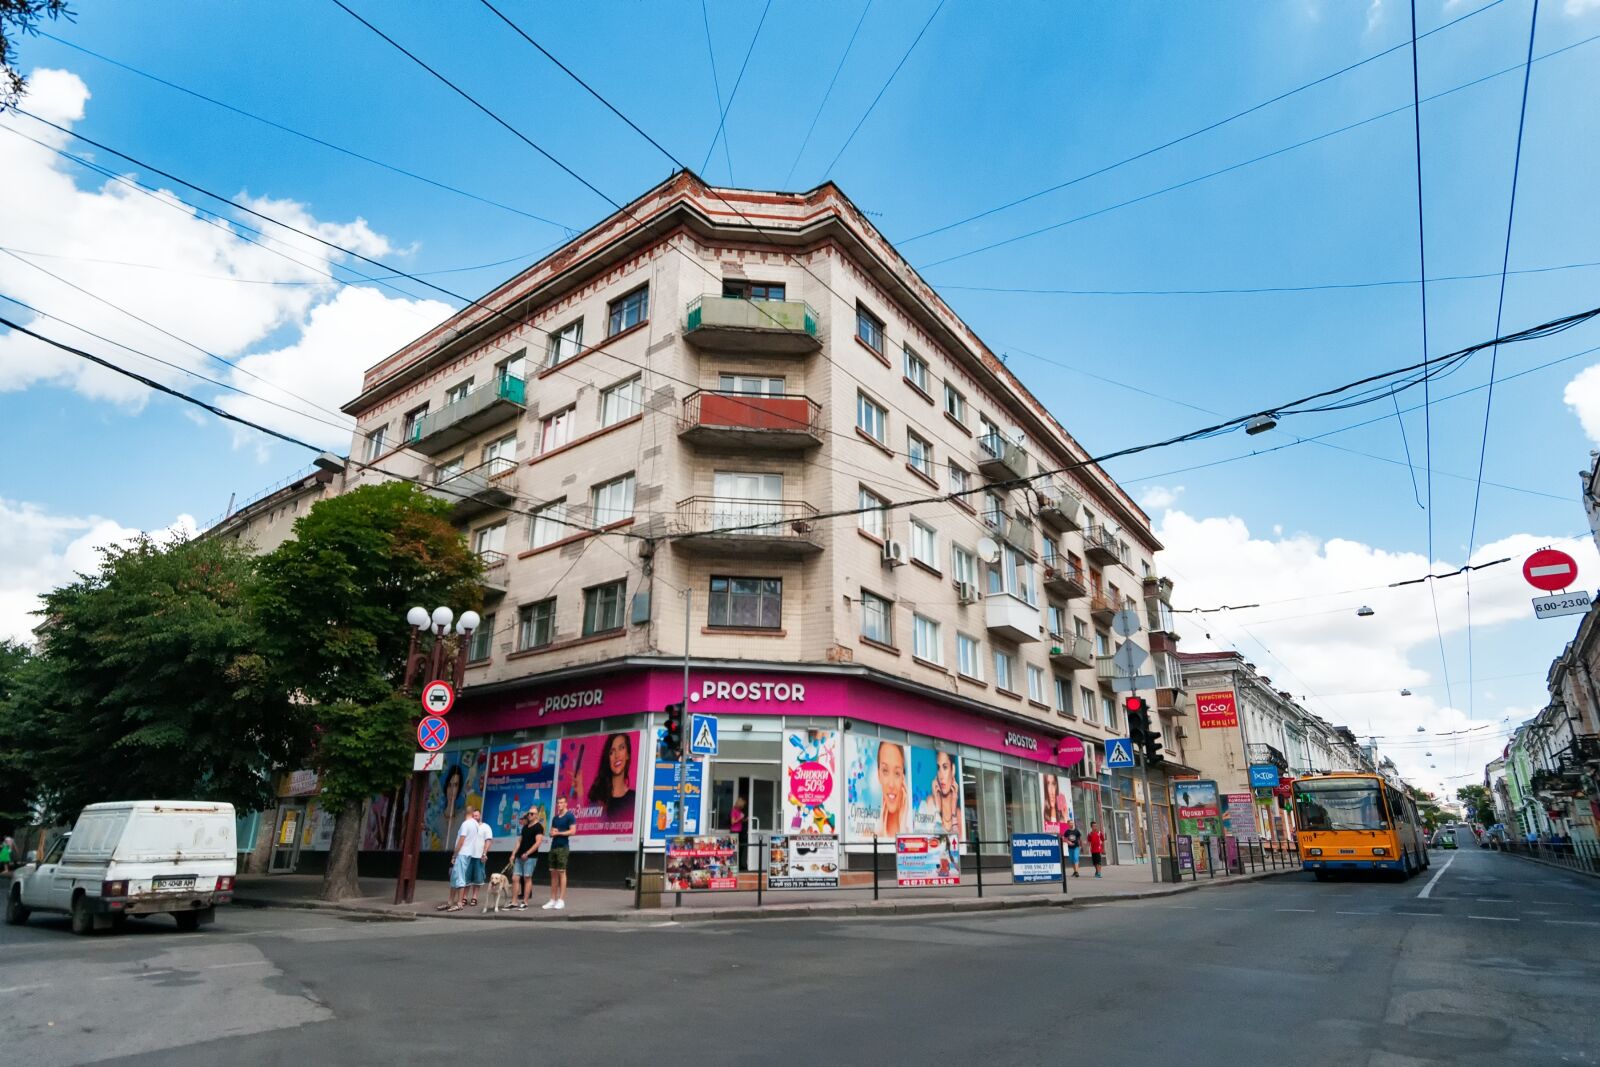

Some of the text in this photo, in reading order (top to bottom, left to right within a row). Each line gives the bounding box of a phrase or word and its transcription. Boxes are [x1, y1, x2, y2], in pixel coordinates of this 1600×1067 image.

[1535, 597, 1589, 612] 6.00-23.00
[1201, 718, 1236, 727] АГЕНЦІЯ
[804, 779, 826, 792] 50%
[1181, 809, 1204, 818] Прокат
